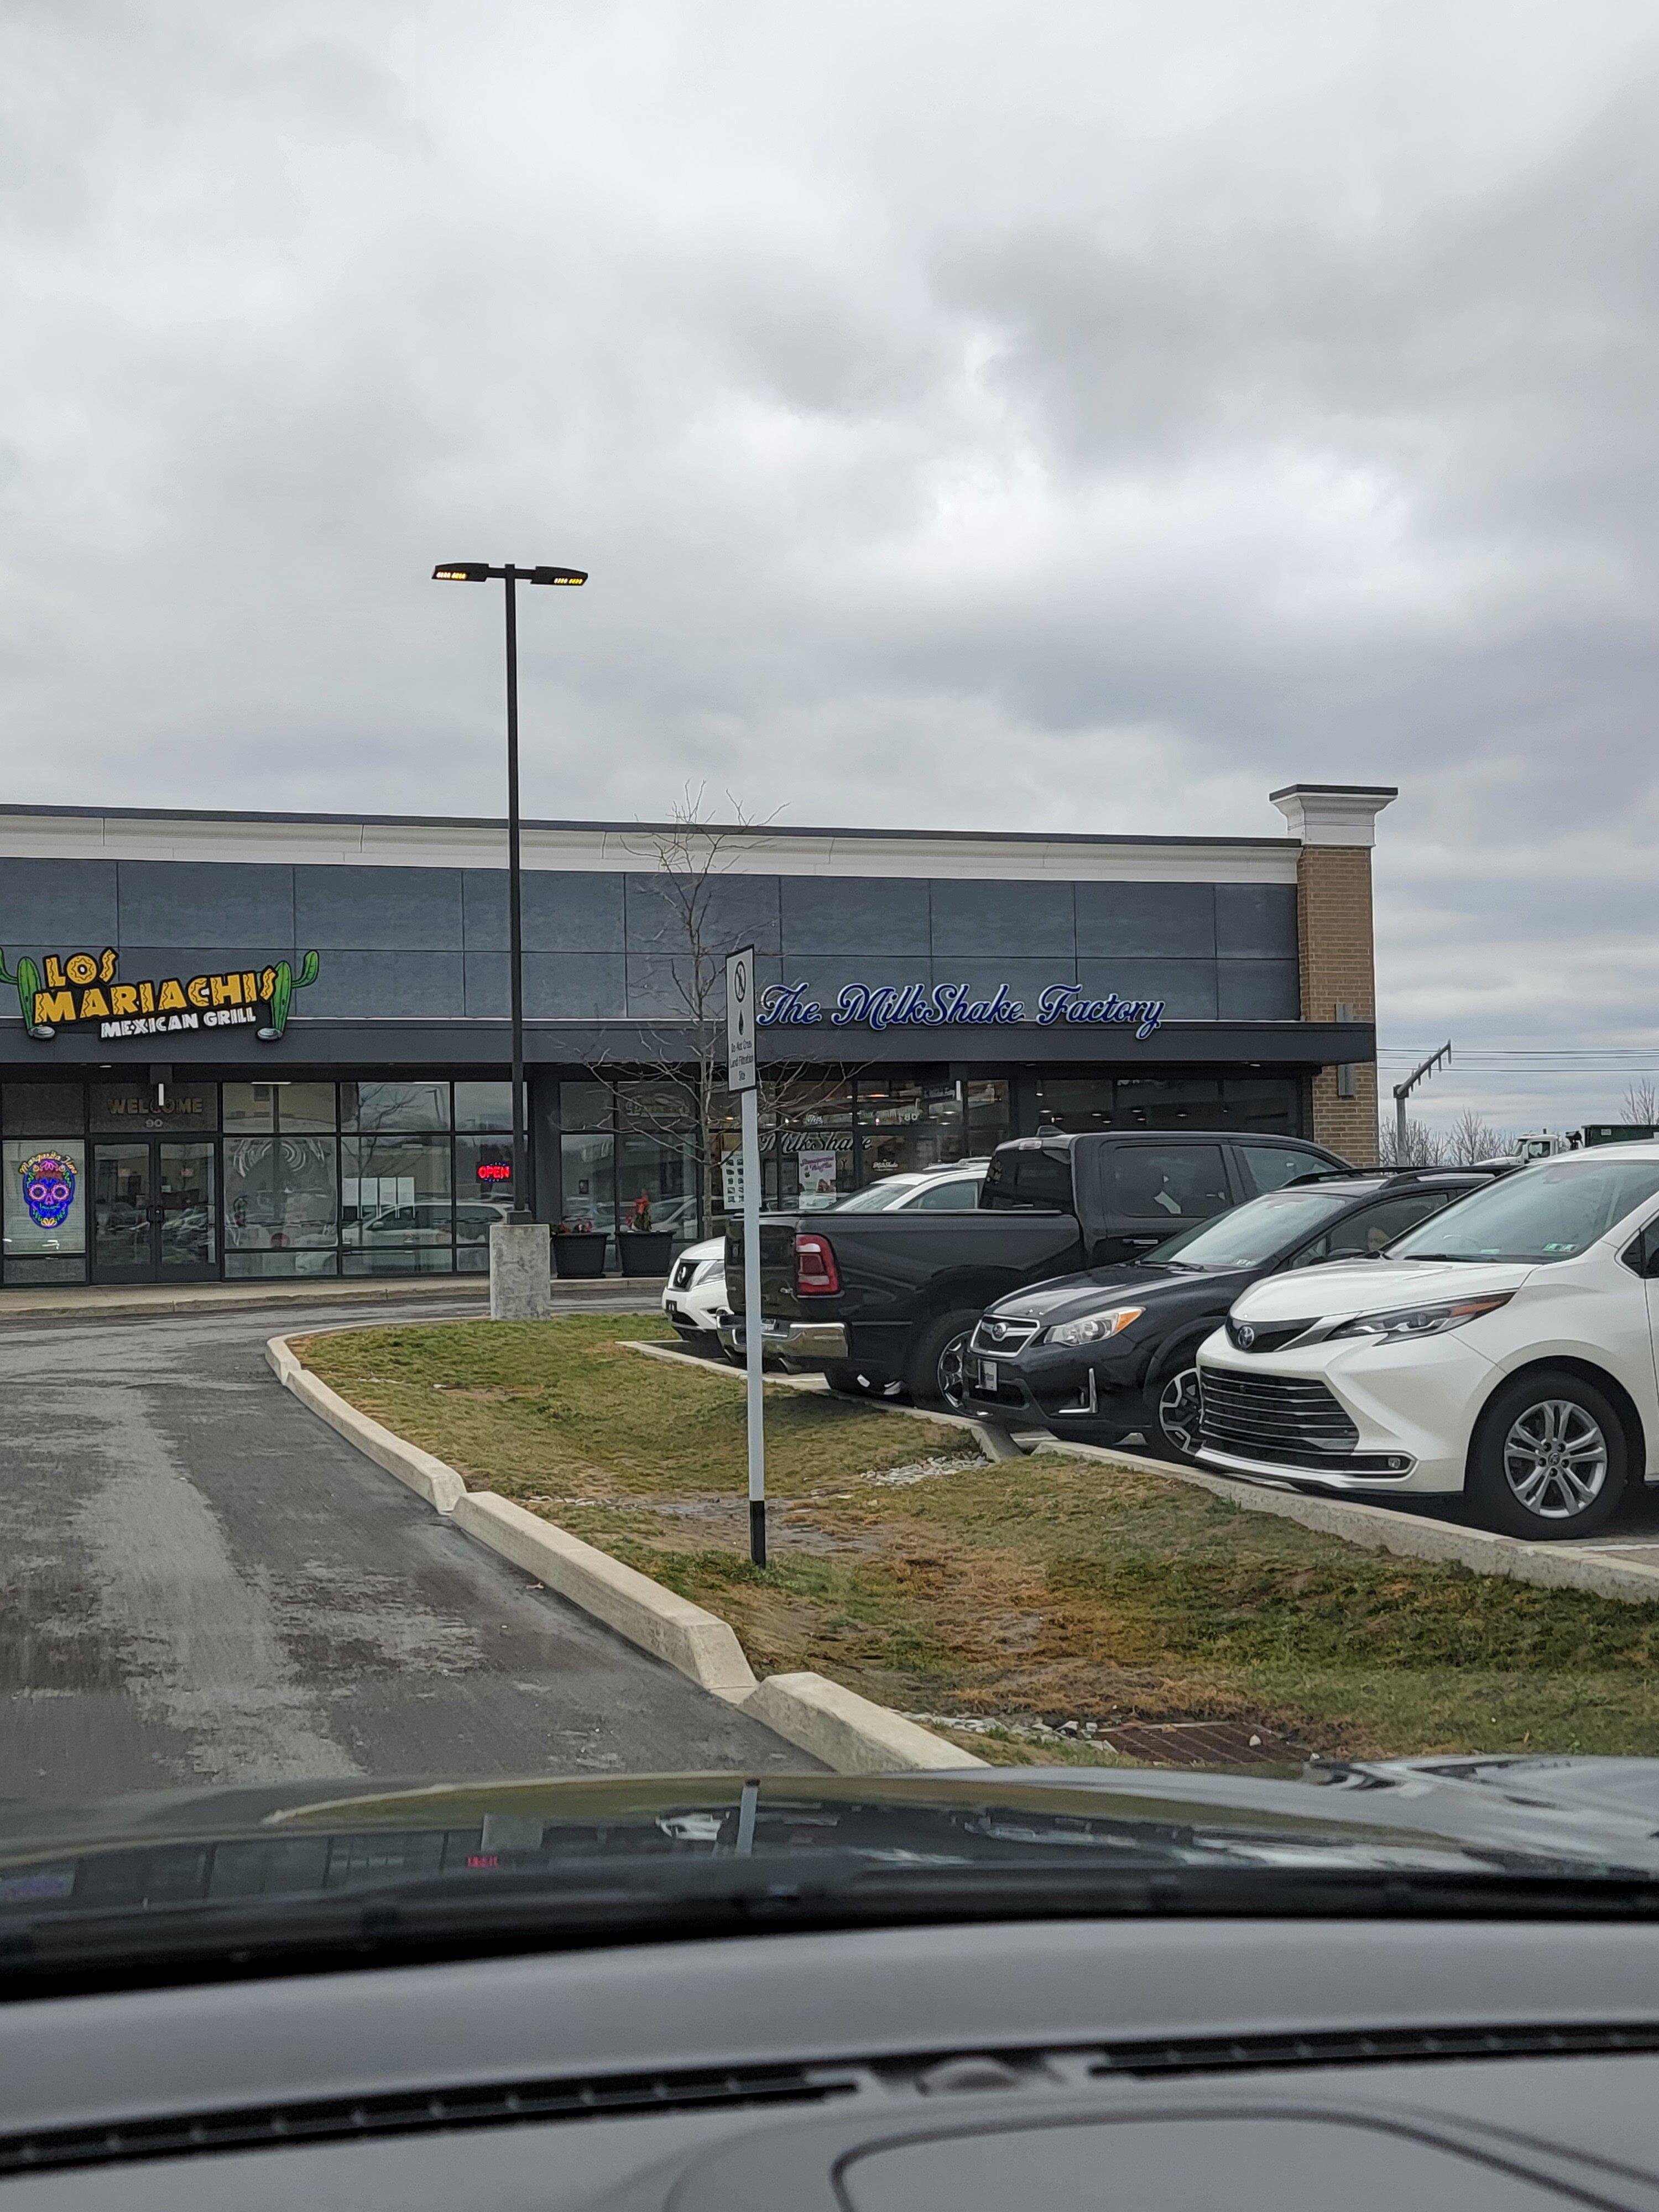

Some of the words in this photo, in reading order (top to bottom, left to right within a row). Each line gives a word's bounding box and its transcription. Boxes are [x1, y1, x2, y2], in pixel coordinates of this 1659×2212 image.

[45, 949, 118, 987] LOS
[34, 968, 276, 1024] MARIACHIS
[101, 1013, 198, 1038] MEXICAN
[204, 1006, 256, 1027] GRILL
[757, 982, 822, 1025] The
[831, 982, 1025, 1030] MilkShake
[1036, 983, 1165, 1040] Factory
[108, 1098, 203, 1114] WELCOME
[145, 1119, 163, 1128] 90
[759, 1131, 873, 1155] MilkShae
[478, 1165, 510, 1179] OPEN
